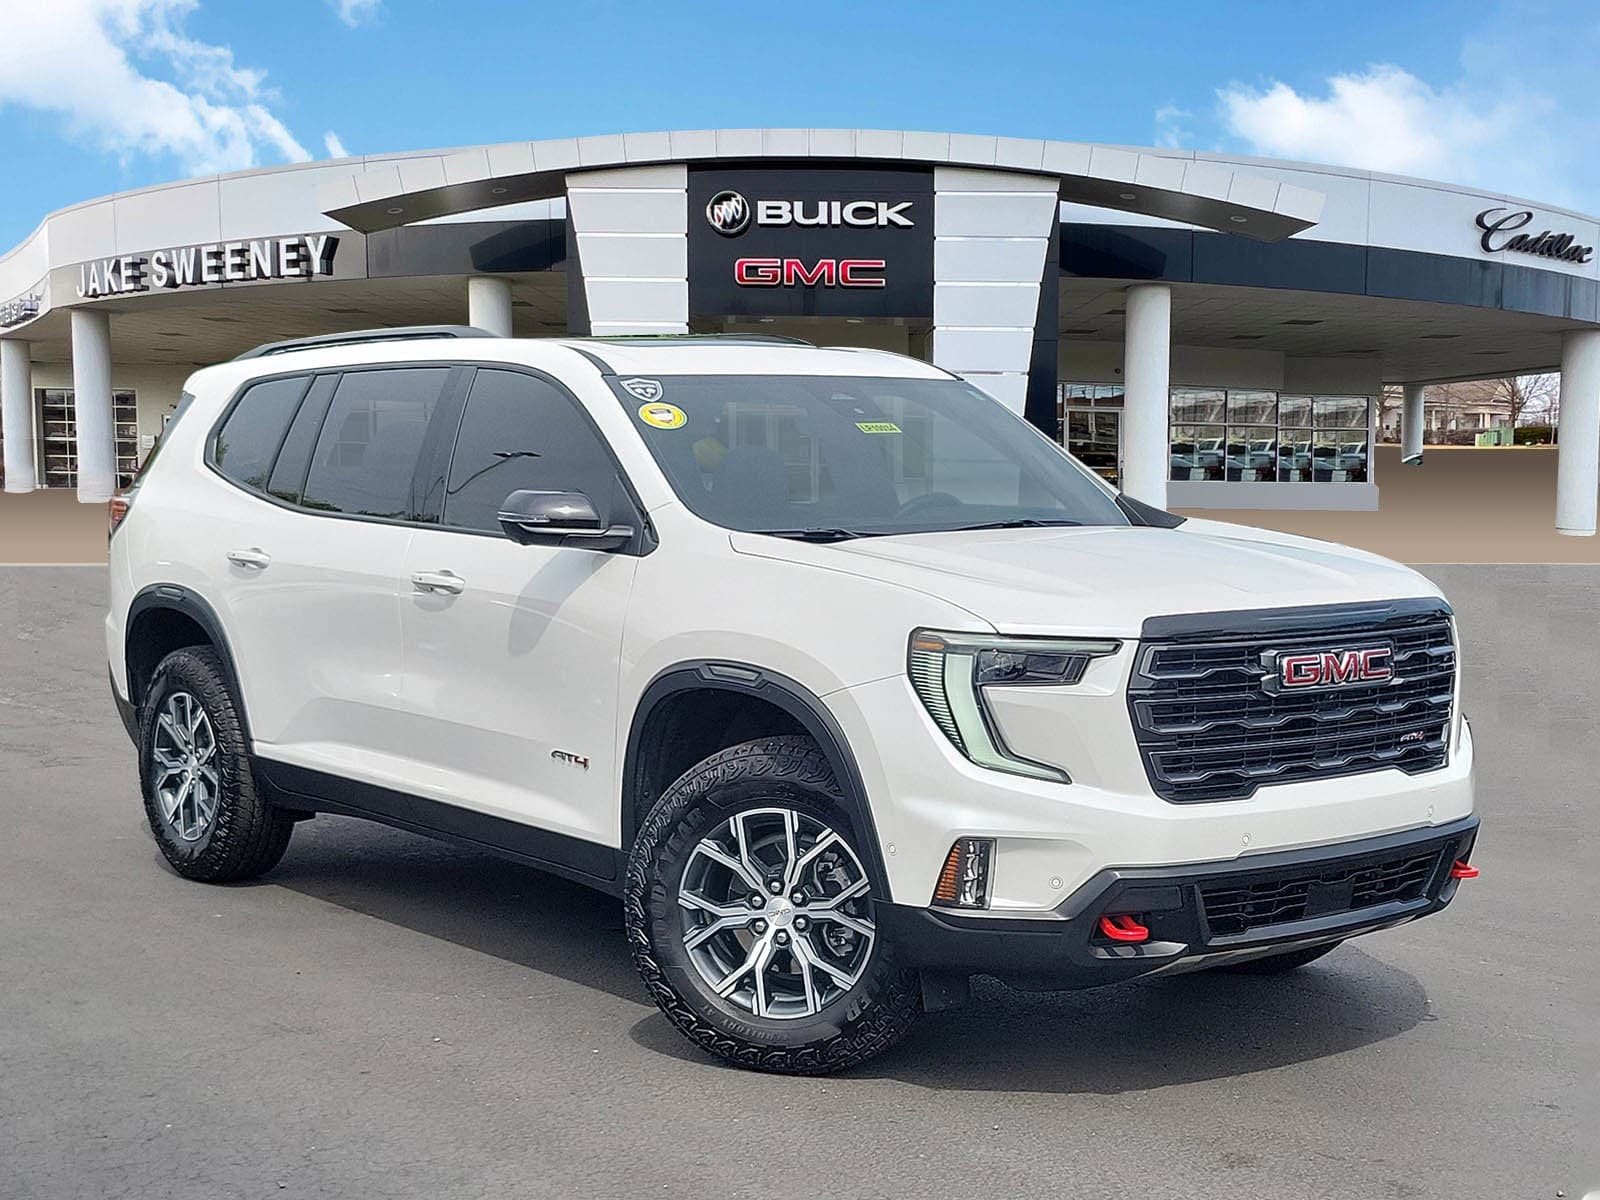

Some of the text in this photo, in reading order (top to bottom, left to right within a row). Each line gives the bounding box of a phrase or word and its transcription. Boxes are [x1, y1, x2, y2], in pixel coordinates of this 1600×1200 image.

[757, 200, 914, 225] BUICK
[1475, 207, 1593, 263] Cadillac
[76, 234, 339, 299] JAKE SWEENEY
[735, 258, 885, 286] GMC
[1281, 648, 1392, 687] GMC
[1400, 731, 1424, 741] AT4
[551, 750, 590, 769] AT4
